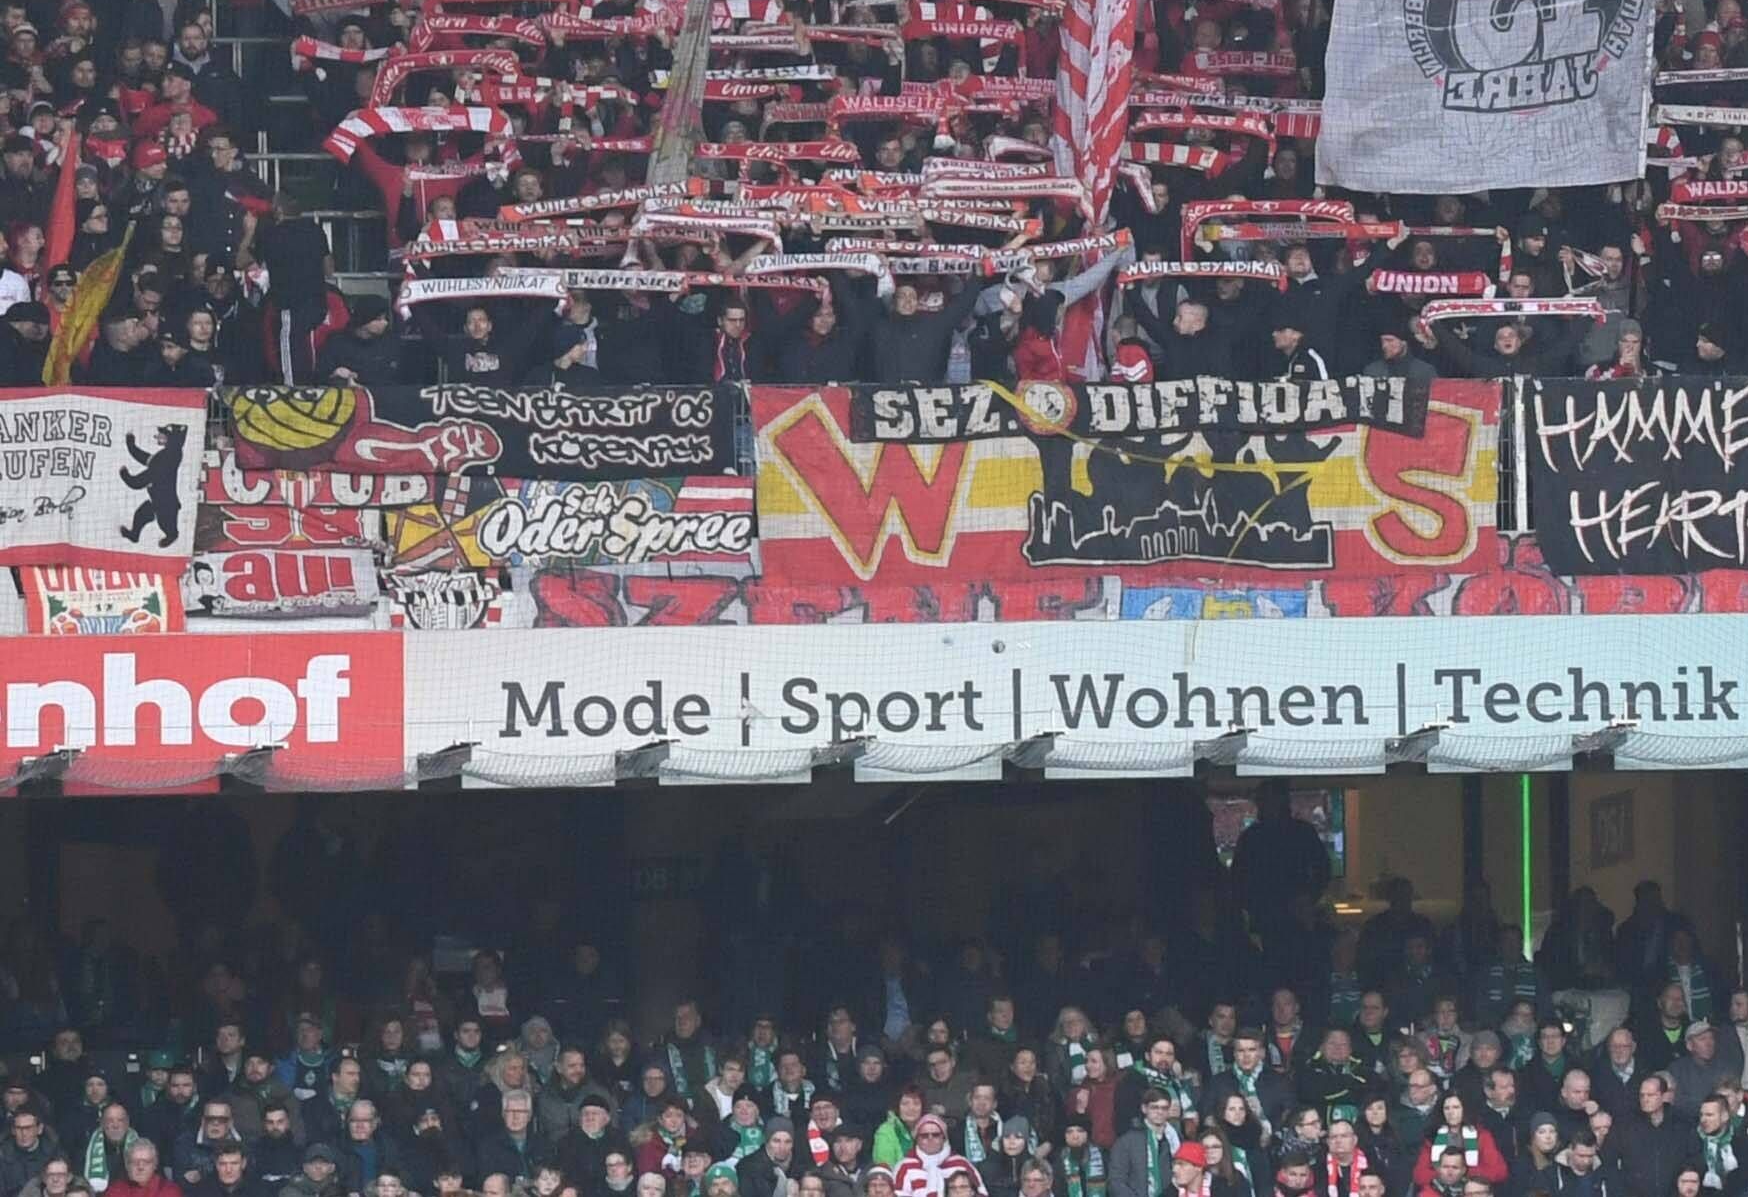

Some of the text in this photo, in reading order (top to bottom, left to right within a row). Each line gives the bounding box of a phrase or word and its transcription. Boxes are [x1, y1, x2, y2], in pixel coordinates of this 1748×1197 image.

[1198, 260, 1284, 276] SYNDIKAT
[1377, 271, 1459, 293] UNION
[872, 374, 1409, 439] SEZ. DIFFIDATI
[0, 447, 96, 481] UFEN
[480, 498, 755, 563] Oder Spree
[6, 652, 351, 748] nhof
[502, 679, 712, 739] Mode
[780, 674, 984, 749] Sport
[1050, 669, 1371, 729] Wohnen
[1433, 664, 1739, 724] Technik
